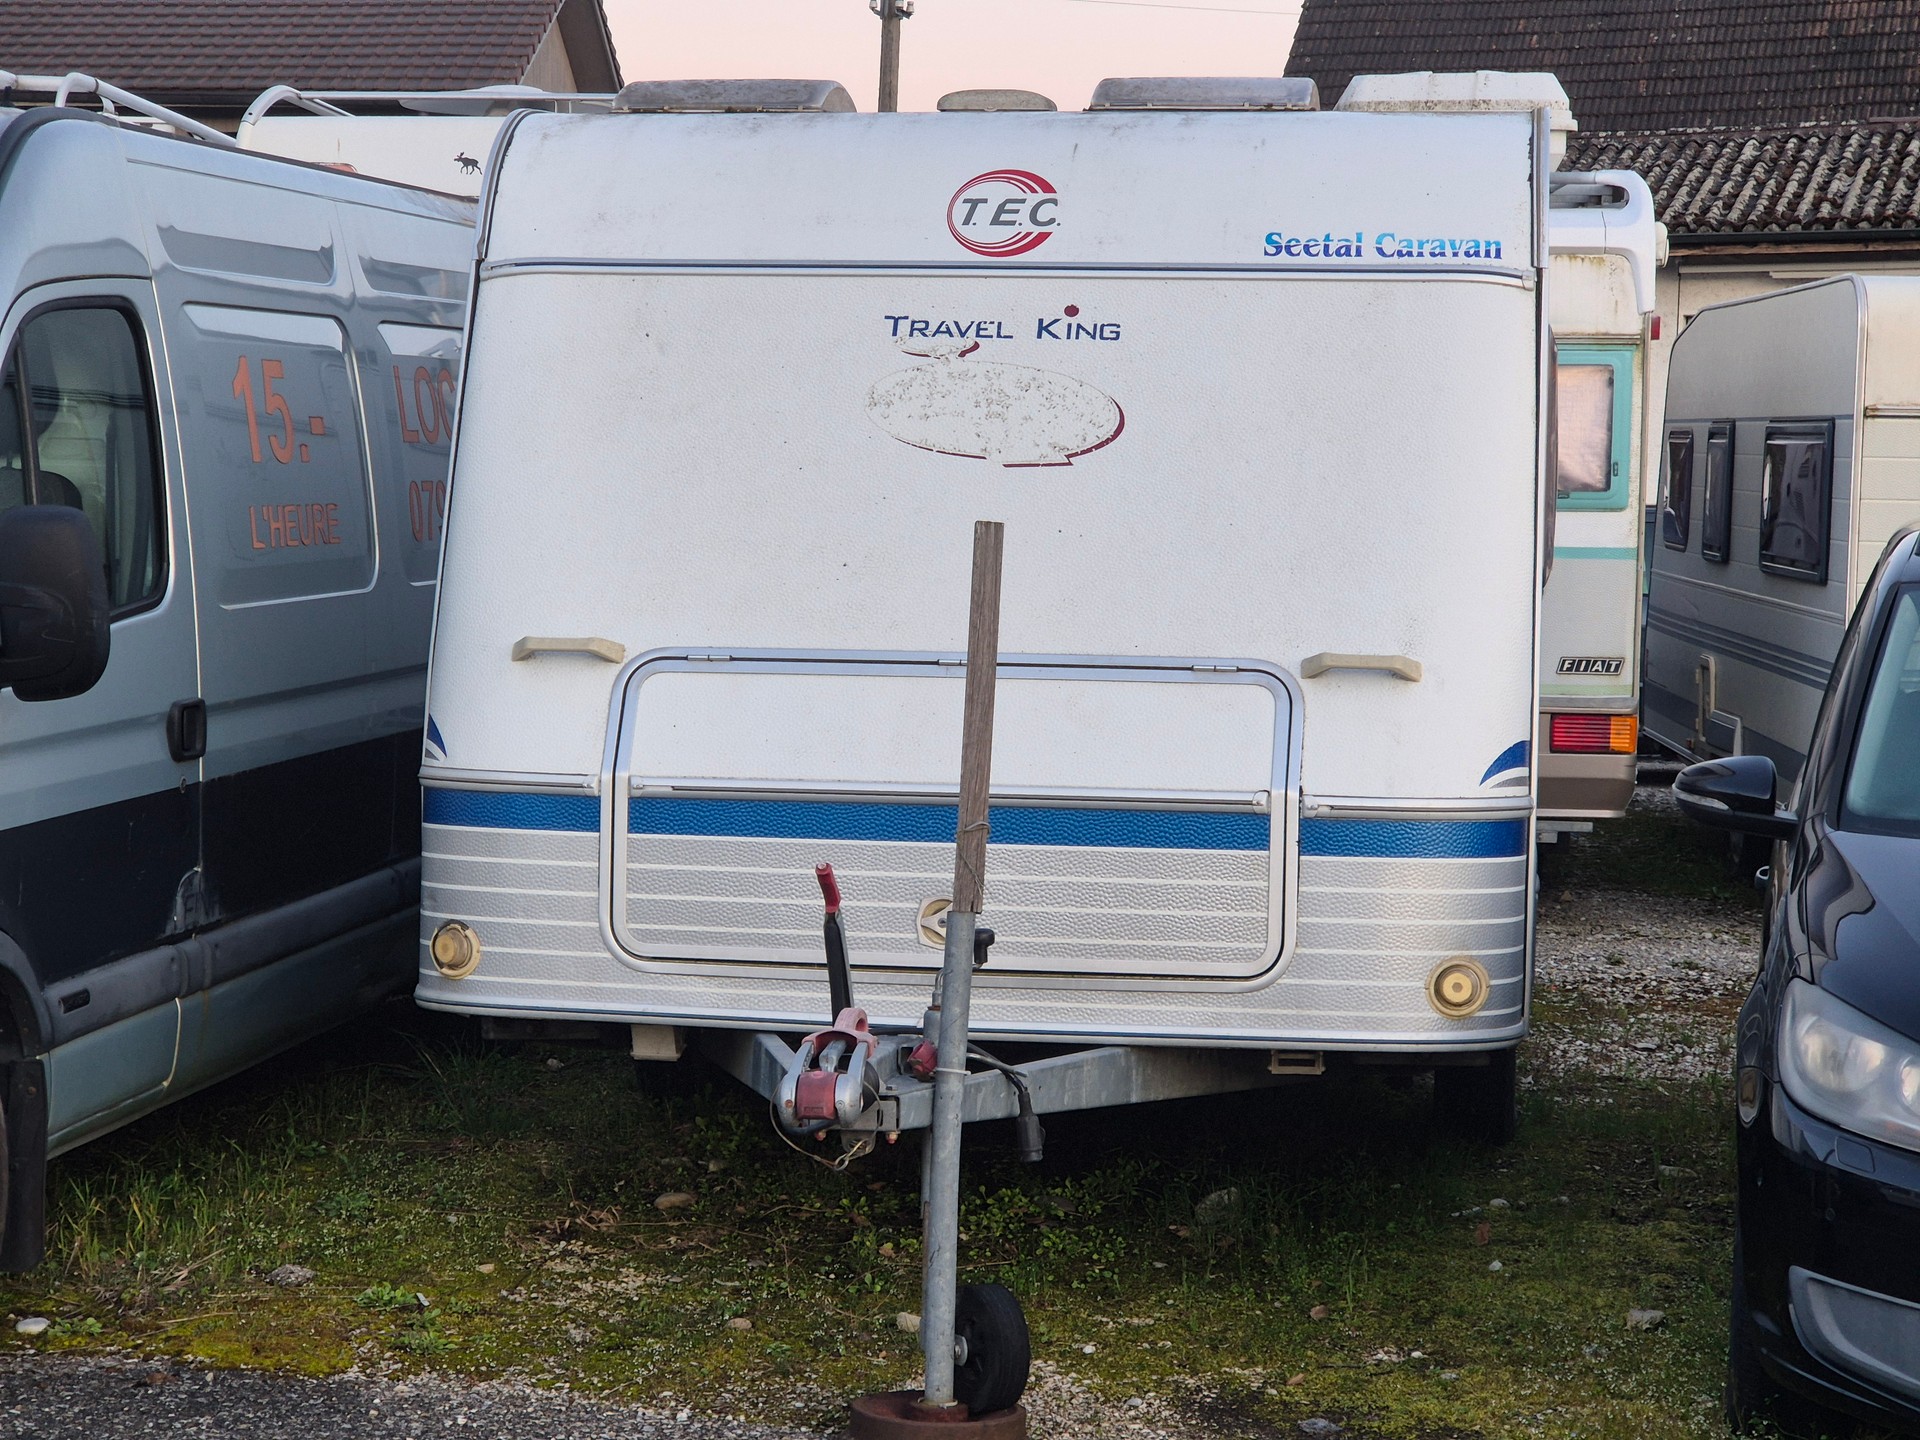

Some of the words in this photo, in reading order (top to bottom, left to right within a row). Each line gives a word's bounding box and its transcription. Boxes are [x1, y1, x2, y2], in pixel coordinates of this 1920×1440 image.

[961, 198, 1062, 227] T.E.C.
[1263, 232, 1363, 258] Seetal
[1374, 232, 1503, 260] Caravan
[249, 503, 341, 549] L'HEURE
[1561, 659, 1621, 673] FIAT
